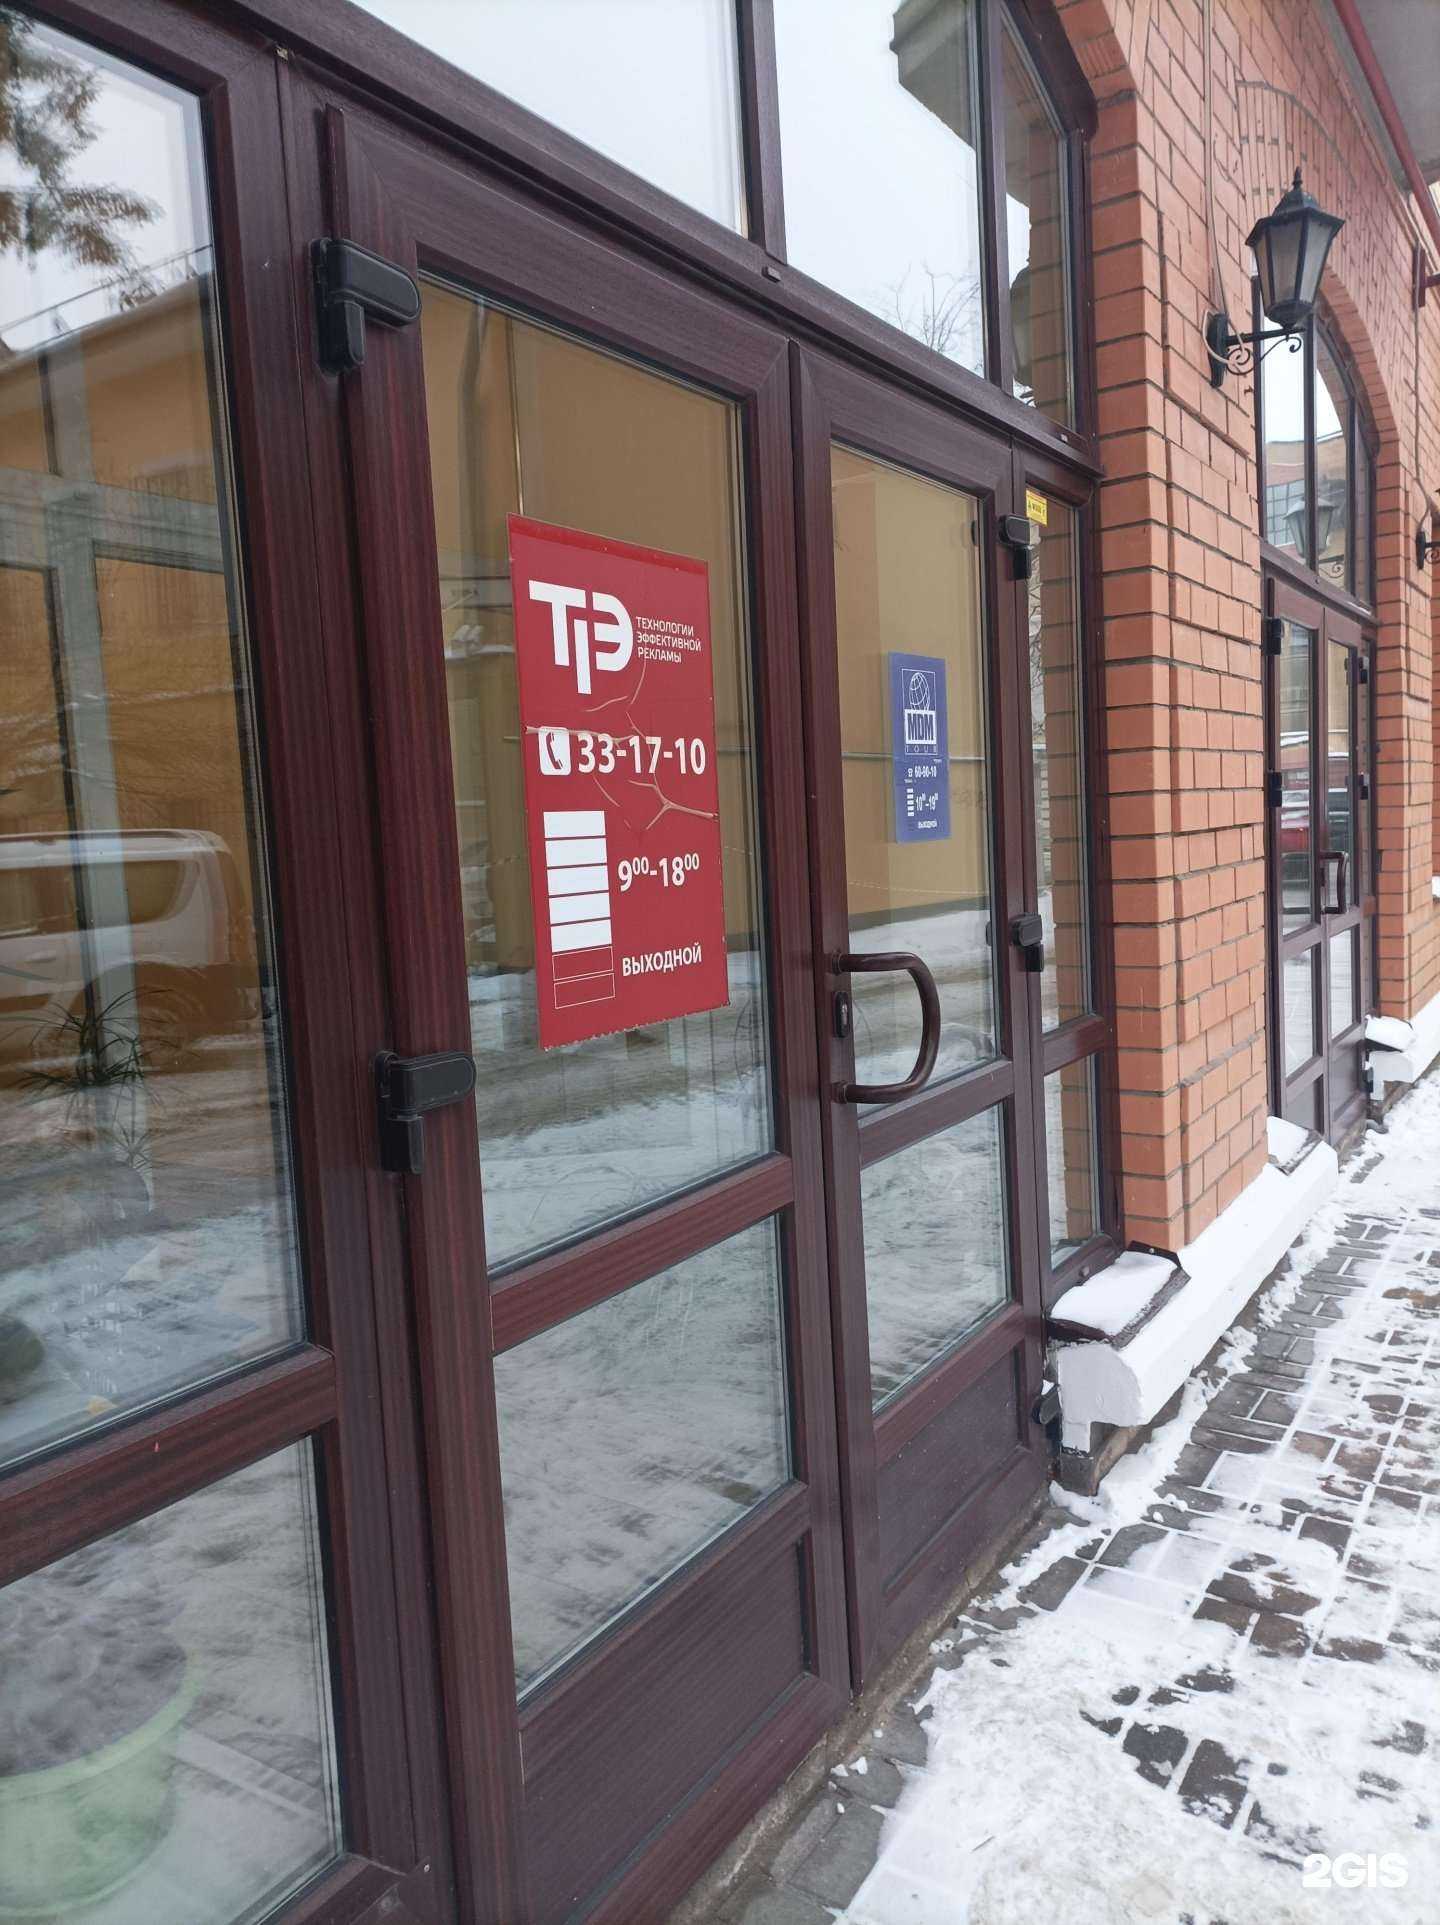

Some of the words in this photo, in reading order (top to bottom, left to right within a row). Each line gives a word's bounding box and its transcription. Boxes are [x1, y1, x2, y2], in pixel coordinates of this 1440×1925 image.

[636, 616, 694, 638] ТЕХНОЛОГИИ
[636, 631, 702, 652] ЭФФЕКТИВНОЙ
[638, 646, 682, 664] РЕКЛАМЫ
[577, 732, 707, 775] 33-17-10
[621, 942, 703, 977] ВЫХОДНОЙ
